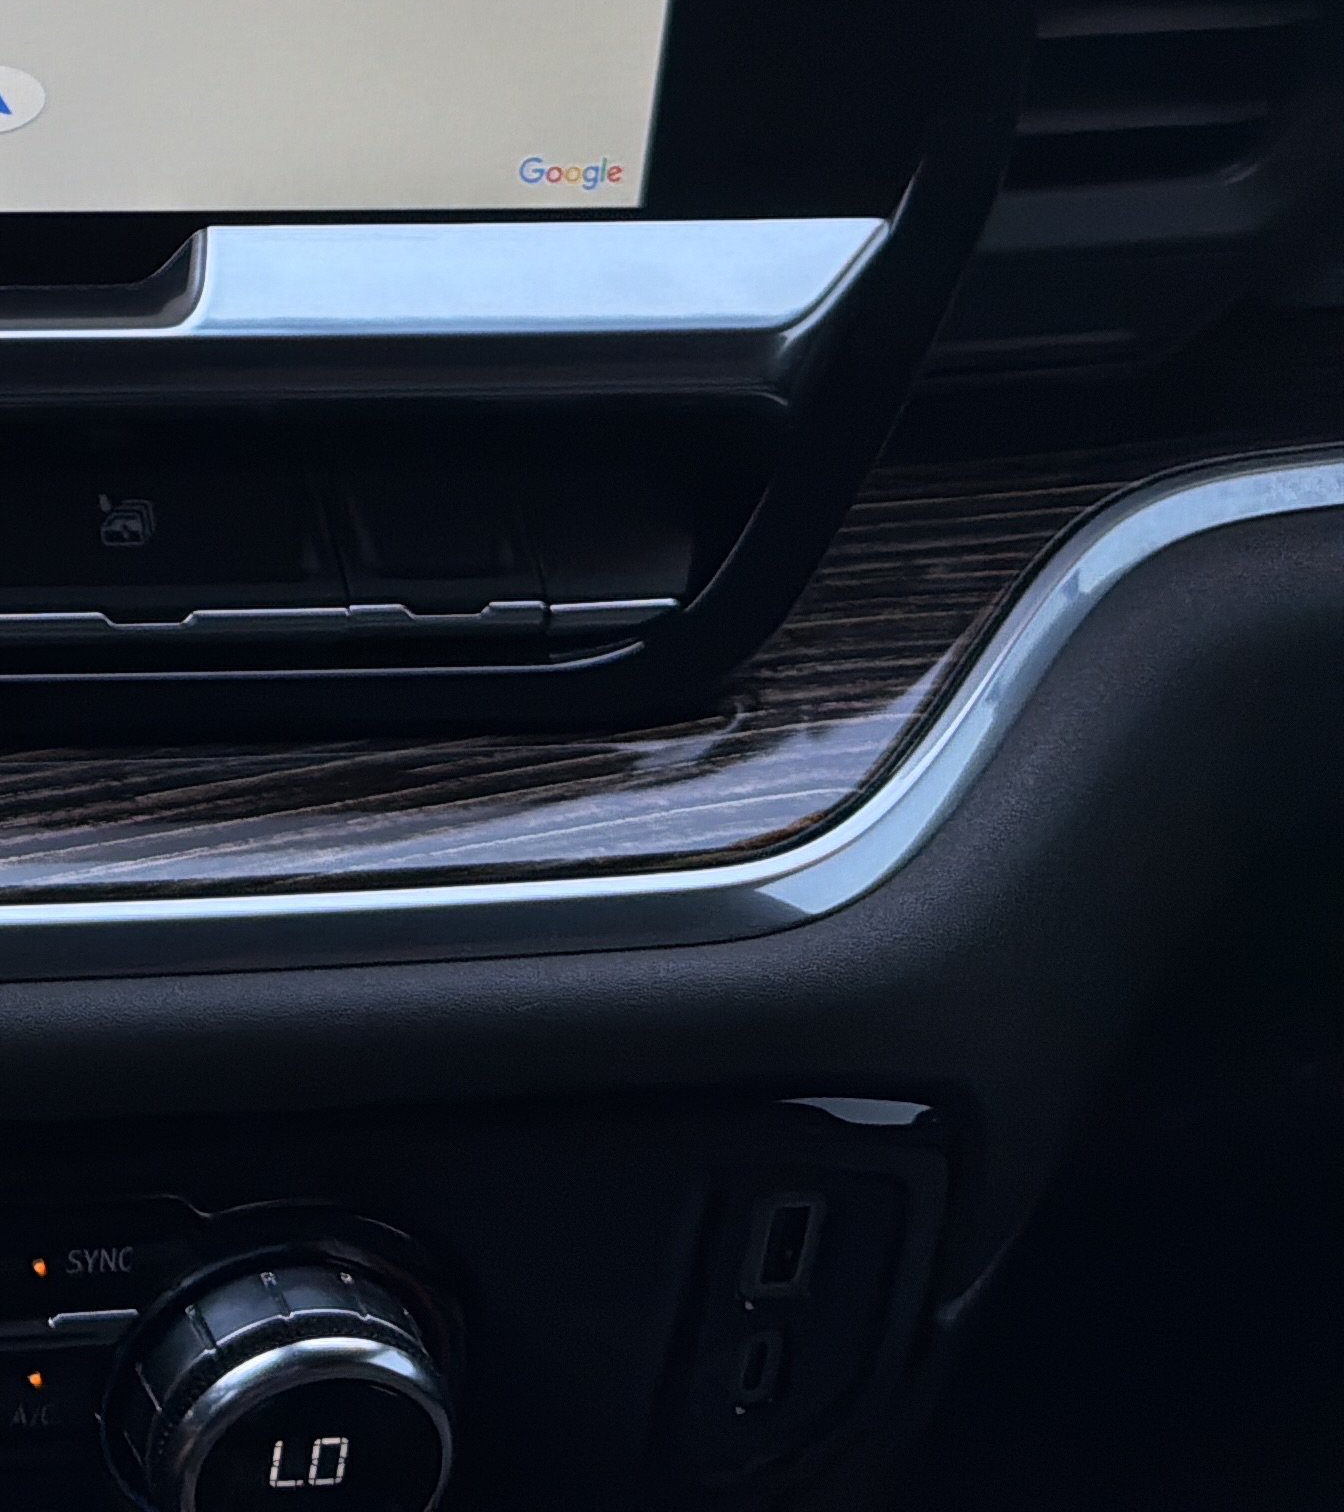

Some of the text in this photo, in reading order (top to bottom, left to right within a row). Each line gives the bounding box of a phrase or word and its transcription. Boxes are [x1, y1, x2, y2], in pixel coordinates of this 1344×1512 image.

[517, 156, 623, 192] Google
[66, 1246, 133, 1275] SYNC
[11, 1403, 54, 1427] A/C
